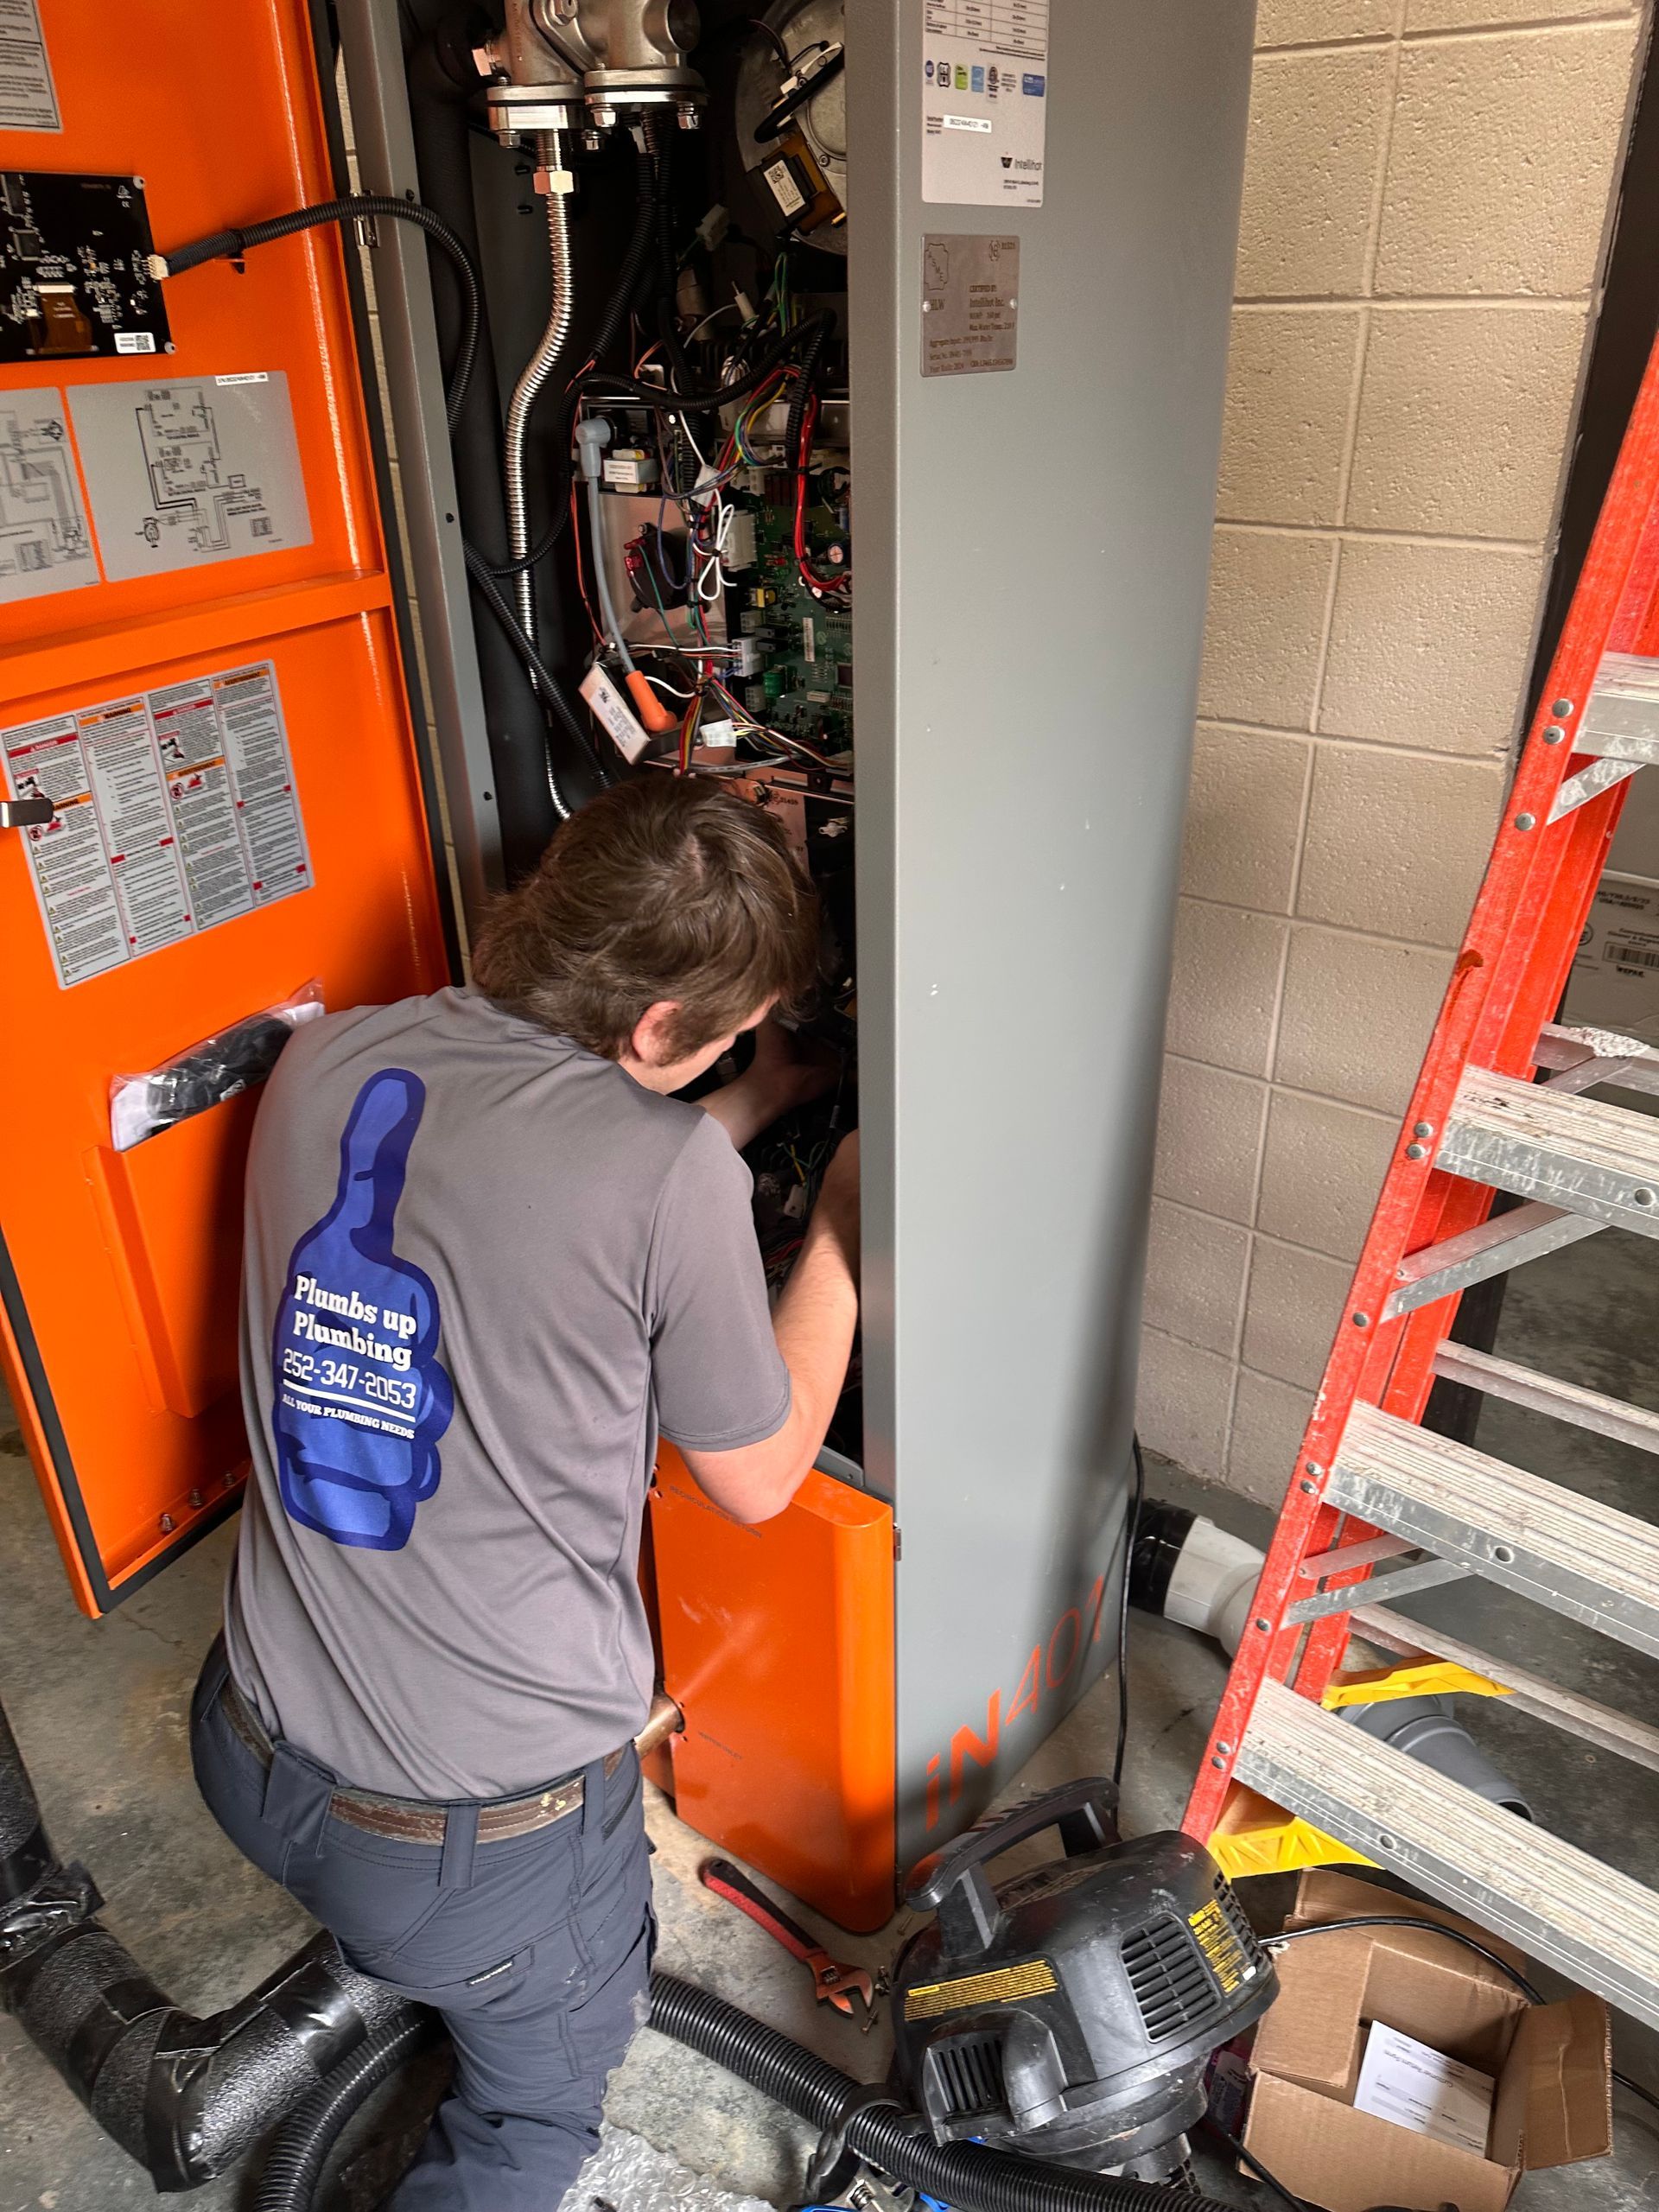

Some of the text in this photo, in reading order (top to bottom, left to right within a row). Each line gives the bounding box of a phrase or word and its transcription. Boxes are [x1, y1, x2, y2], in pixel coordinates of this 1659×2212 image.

[294, 1274, 417, 1339] Plumbs up
[293, 1311, 412, 1372] Plumbing
[283, 1348, 417, 1409] 252-347-2053
[282, 1393, 415, 1440] ALL YOUR PLUMBING NEEDS
